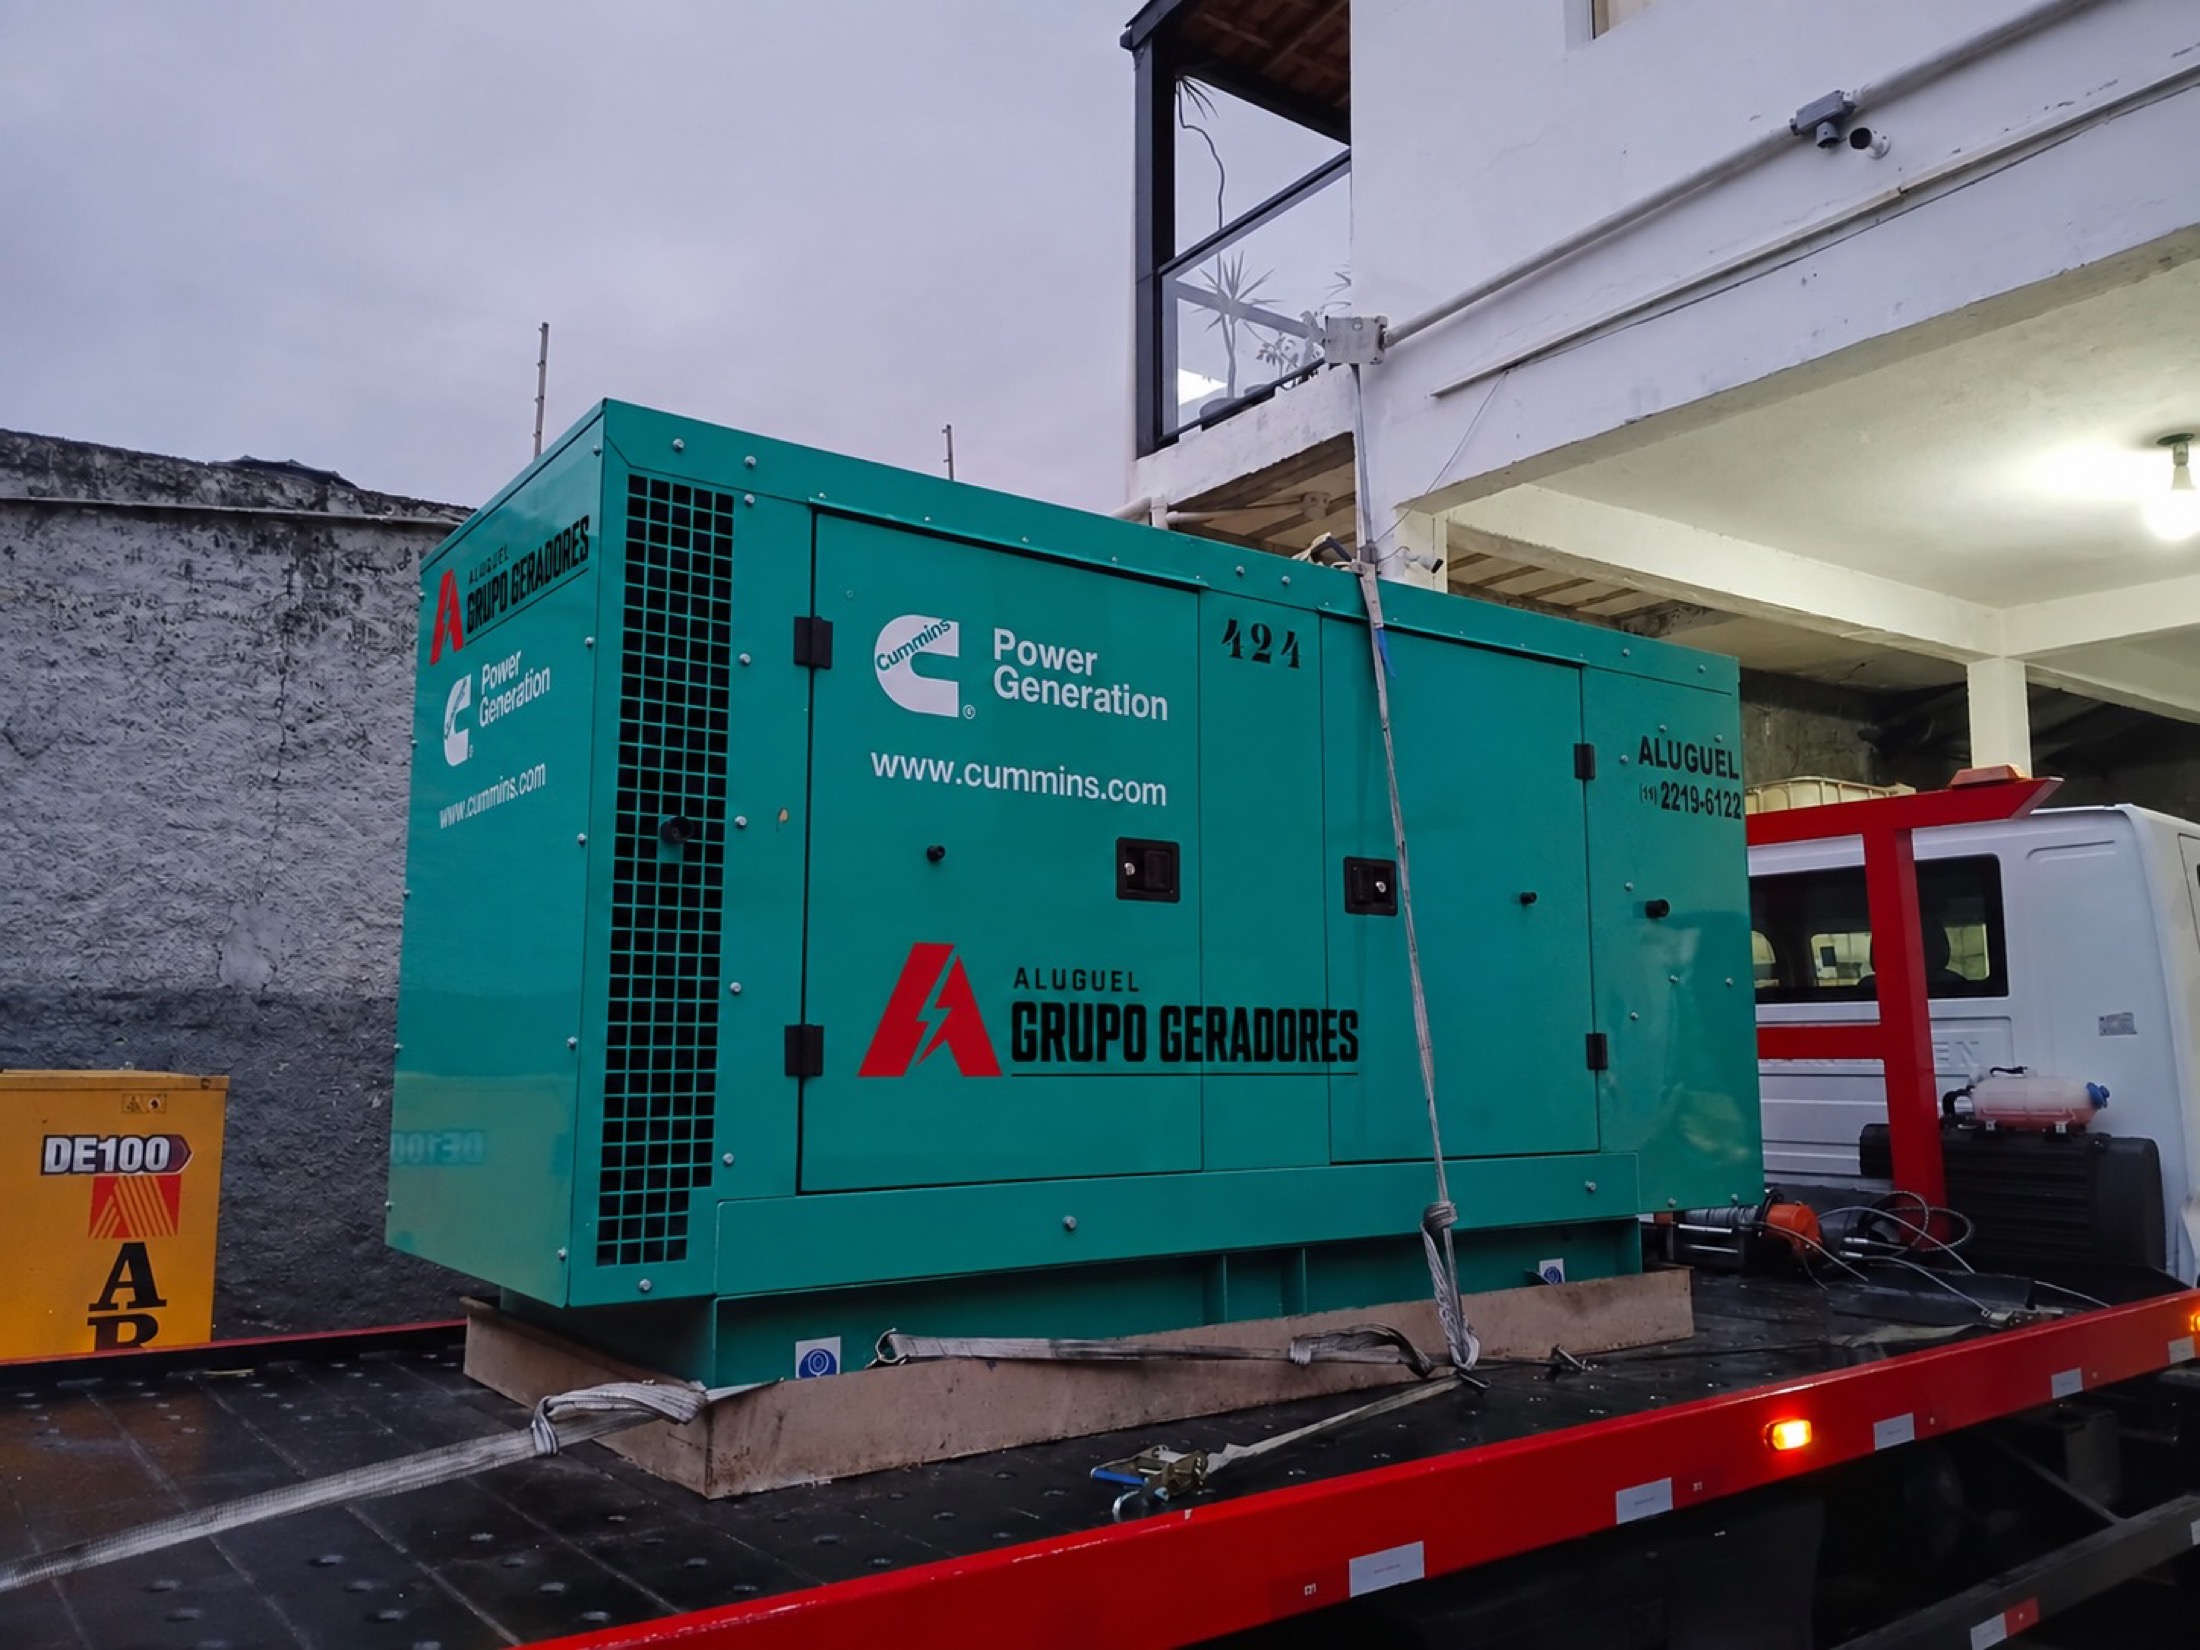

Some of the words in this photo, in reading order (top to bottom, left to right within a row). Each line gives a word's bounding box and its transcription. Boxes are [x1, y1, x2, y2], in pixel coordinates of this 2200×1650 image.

[467, 569, 508, 634] GRUPO
[511, 515, 589, 605] GERADORES
[876, 619, 951, 671] Cummins
[994, 628, 1097, 677] Power
[1221, 617, 1300, 669] 424
[479, 667, 551, 728] Generation
[481, 650, 521, 694] Power
[994, 666, 1168, 722] Generation
[870, 750, 1168, 807] www.cummins.com
[1638, 735, 1739, 779] ALUGUEL
[439, 762, 546, 829] www.cummins.com
[1660, 780, 1742, 819] 2219-6122
[1013, 967, 1140, 993] ALUGUEL
[1011, 1001, 1147, 1063] GRUPO
[1158, 1005, 1360, 1063] GERADORES
[43, 1136, 171, 1174] DE100
